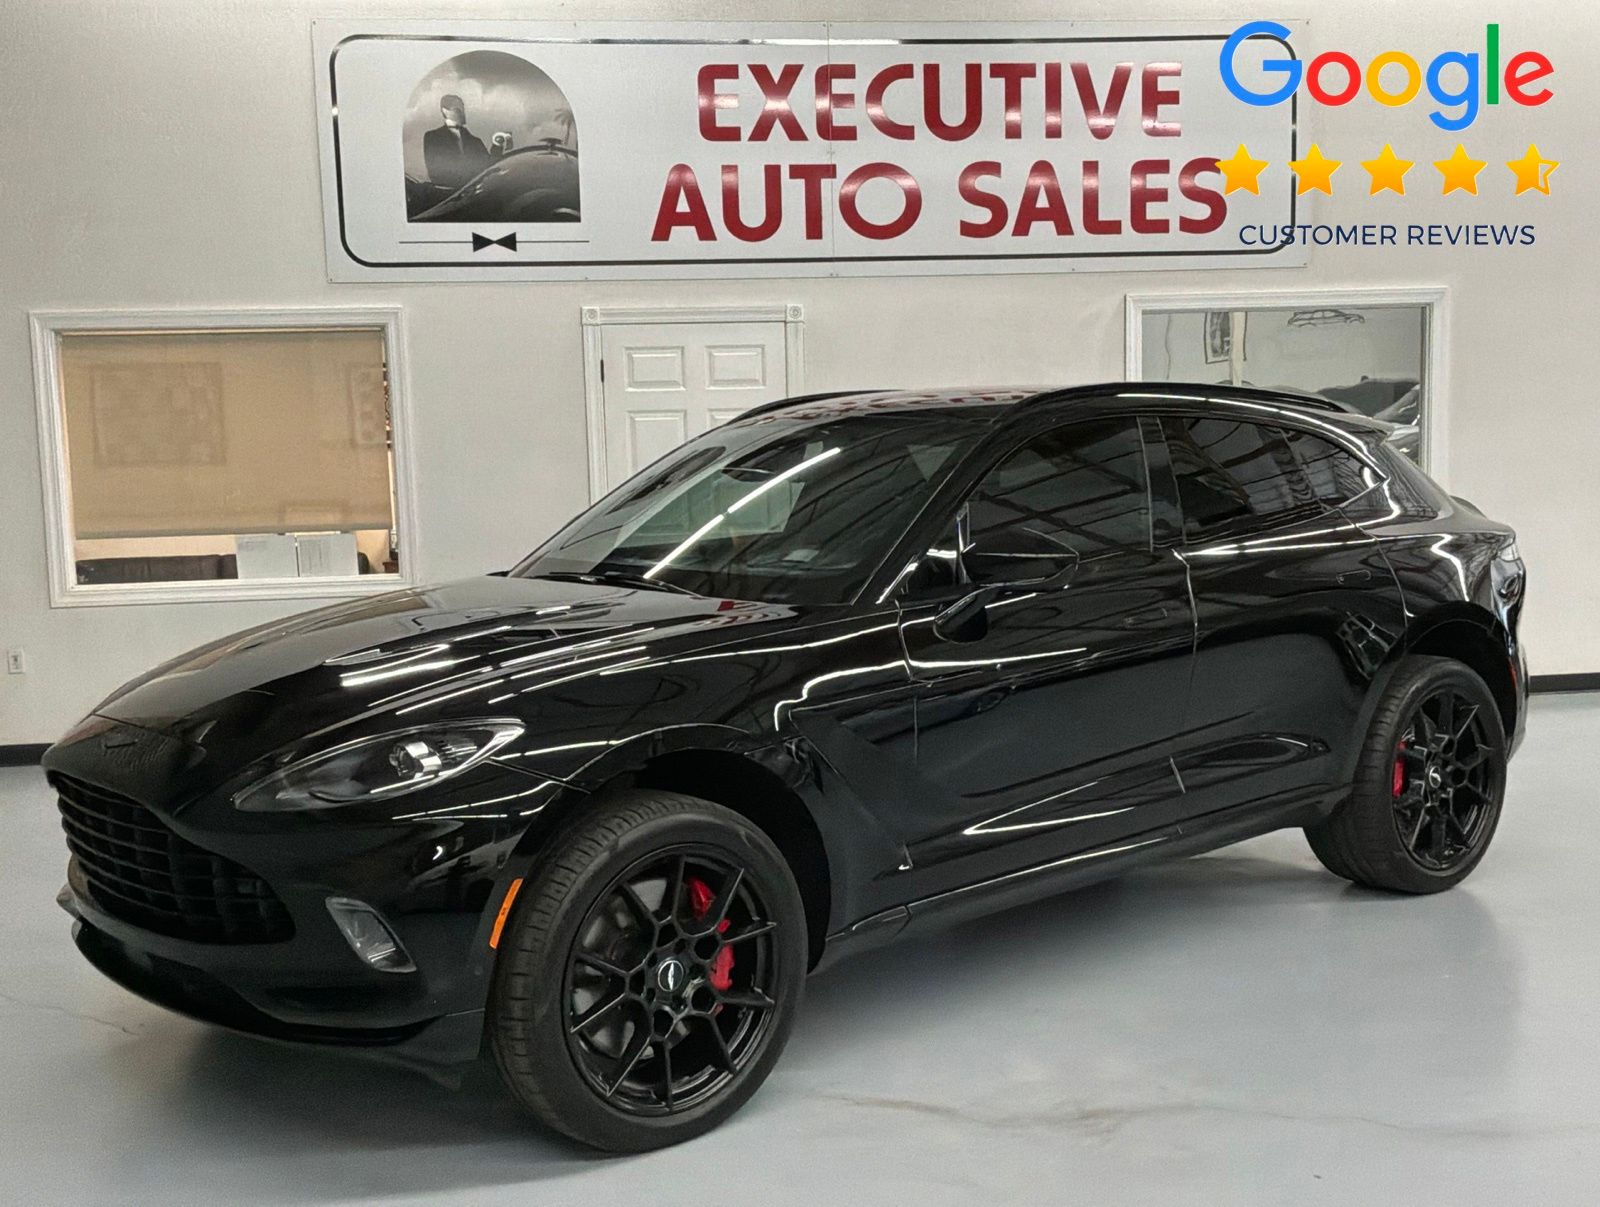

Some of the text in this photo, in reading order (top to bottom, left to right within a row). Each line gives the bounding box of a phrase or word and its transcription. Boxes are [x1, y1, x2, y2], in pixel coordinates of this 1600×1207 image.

[697, 62, 1182, 143] EXECUTIVE
[651, 155, 1227, 243] AUTO SALES
